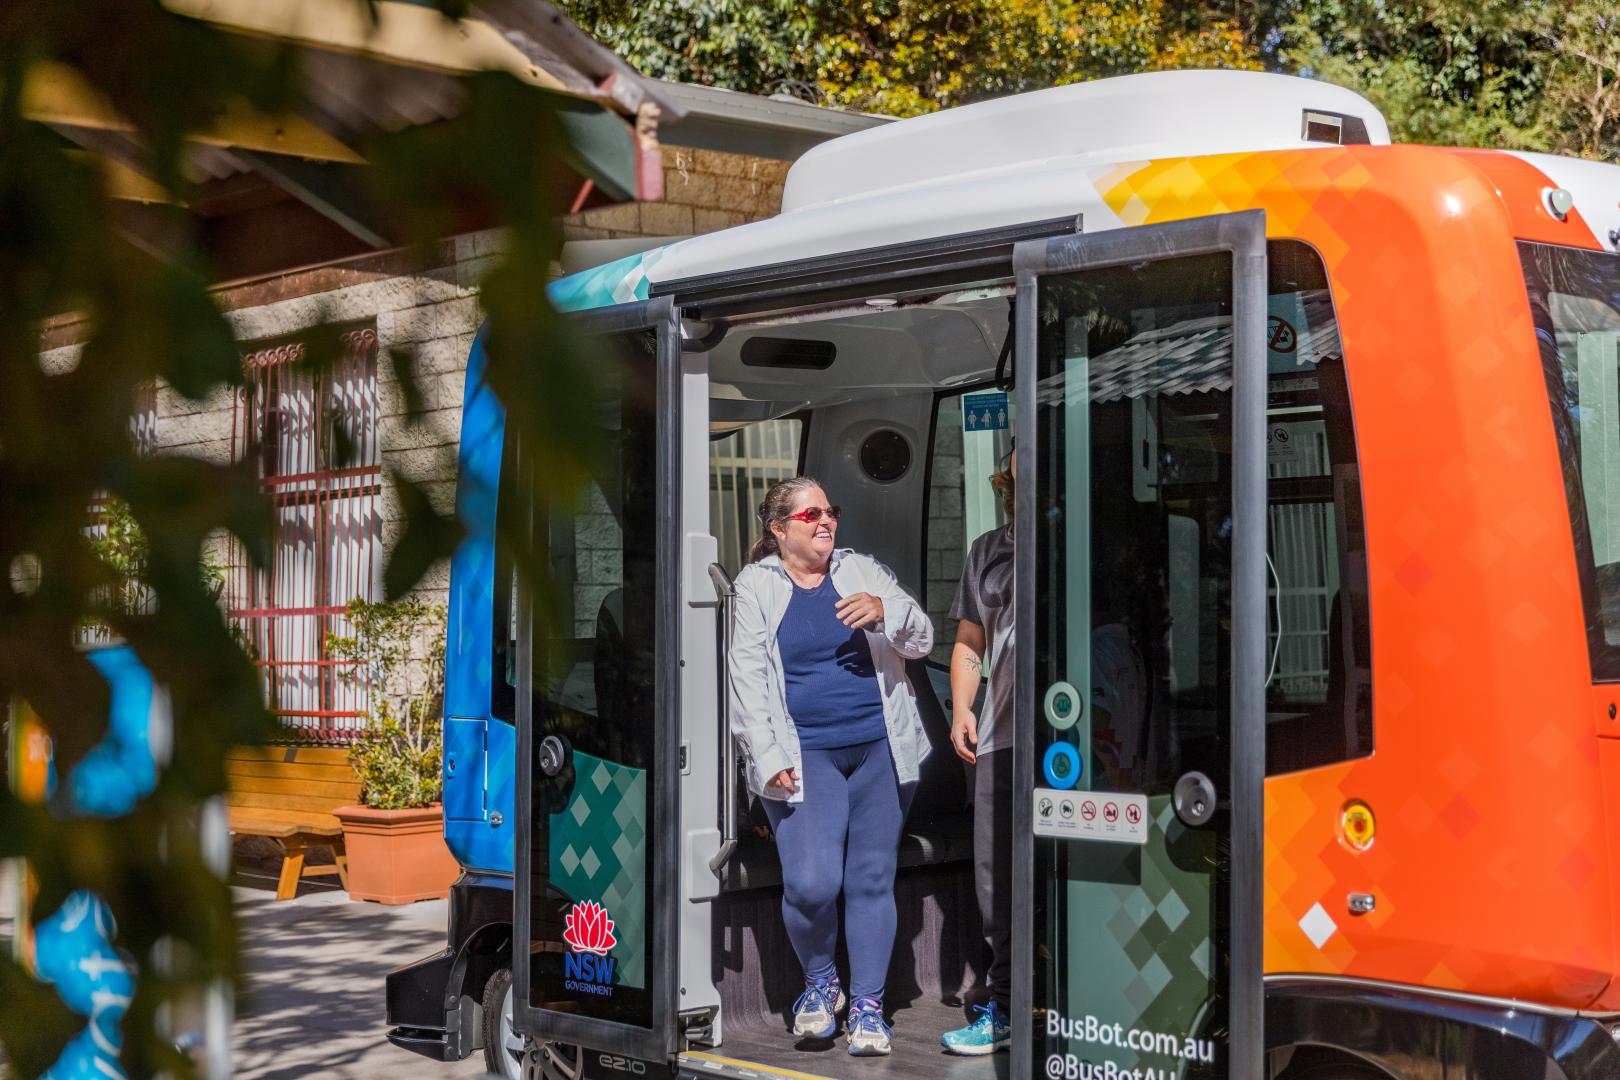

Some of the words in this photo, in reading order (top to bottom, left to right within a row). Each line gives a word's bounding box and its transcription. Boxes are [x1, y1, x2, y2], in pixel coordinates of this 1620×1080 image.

[565, 951, 614, 985] NSW
[564, 980, 613, 997] GOVERNMENT
[1046, 1009, 1214, 1062] BusBot.com.au
